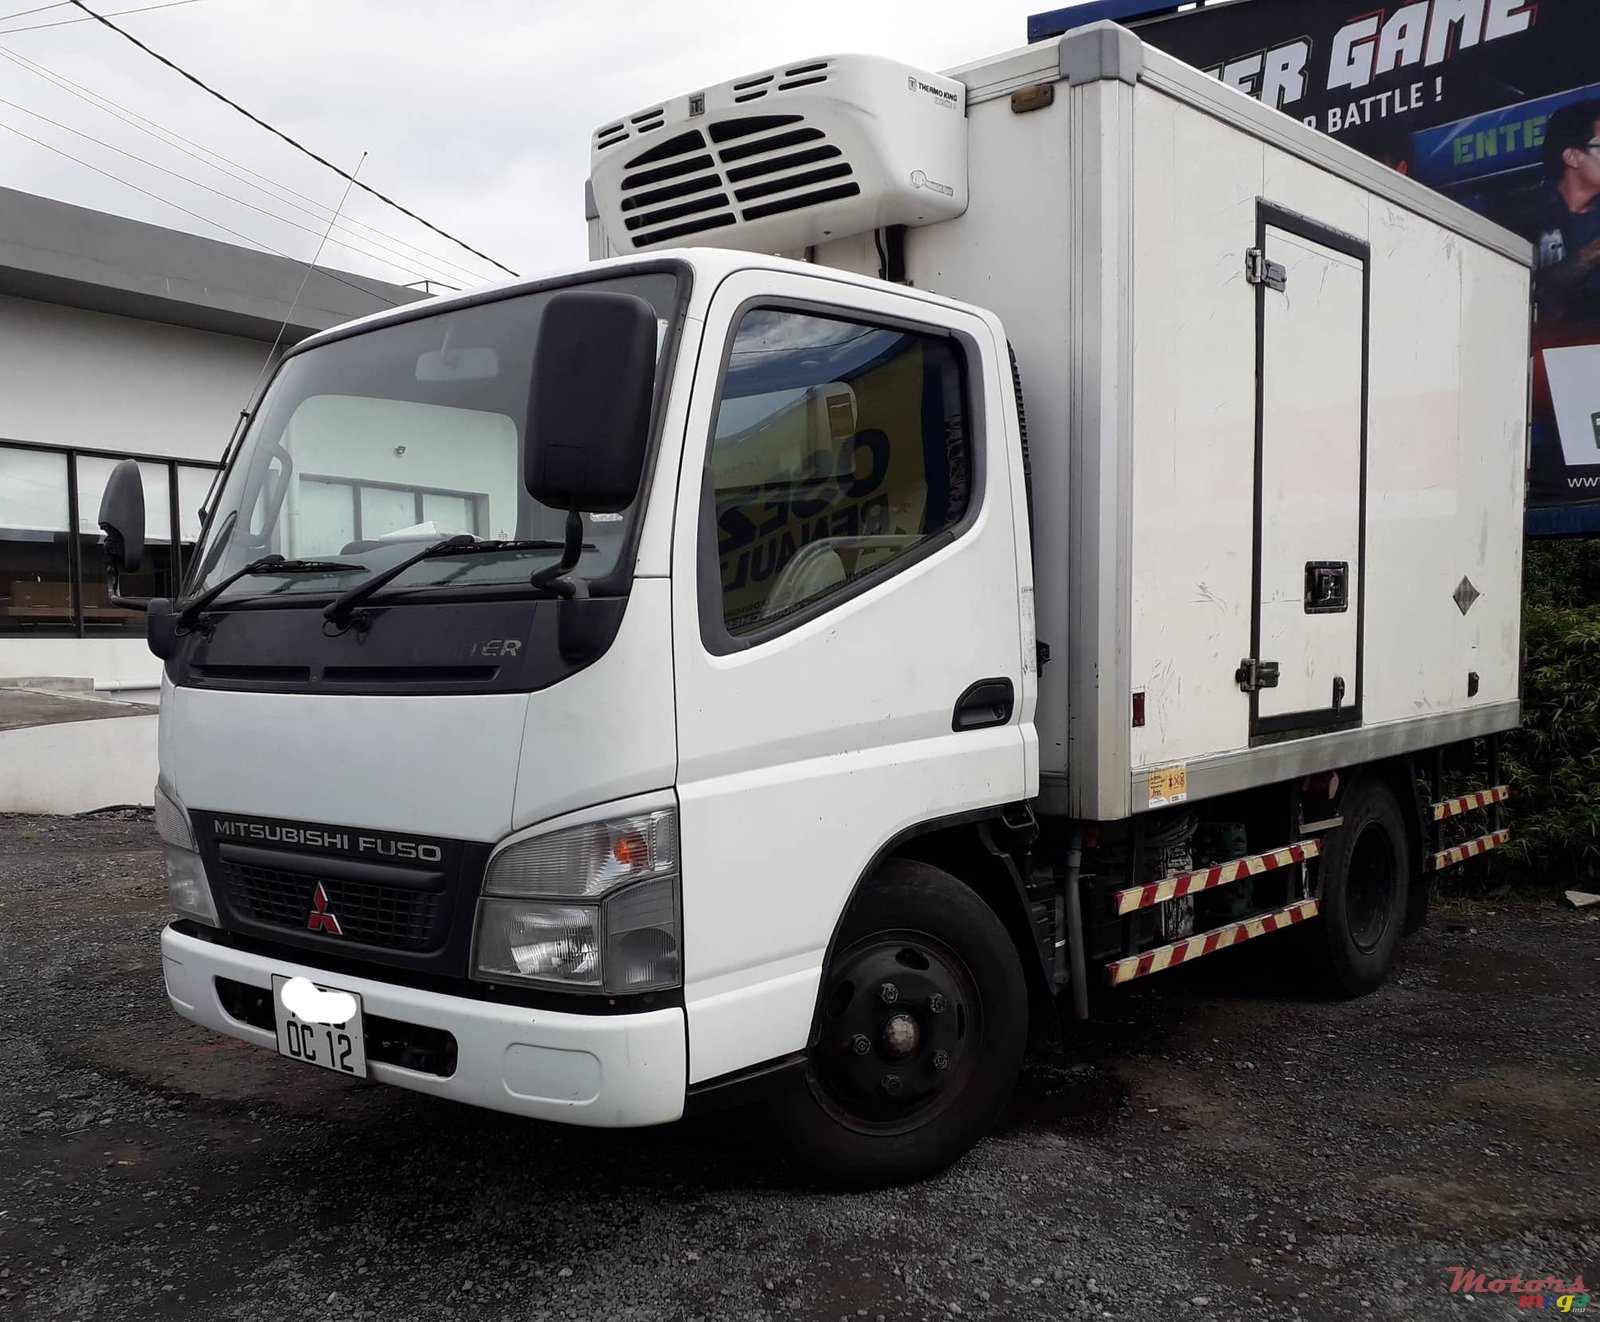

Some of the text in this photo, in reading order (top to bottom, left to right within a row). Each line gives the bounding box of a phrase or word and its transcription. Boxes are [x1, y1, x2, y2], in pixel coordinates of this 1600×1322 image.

[1203, 0, 1531, 110] ER GAME
[918, 82, 943, 97] THERMO
[944, 91, 958, 103] KING
[1328, 82, 1424, 133] BATTLE
[1435, 76, 1443, 102] !
[1453, 113, 1551, 166] ENTE
[213, 819, 442, 862] MITSUBISHI FUSO
[326, 1030, 354, 1073] 12
